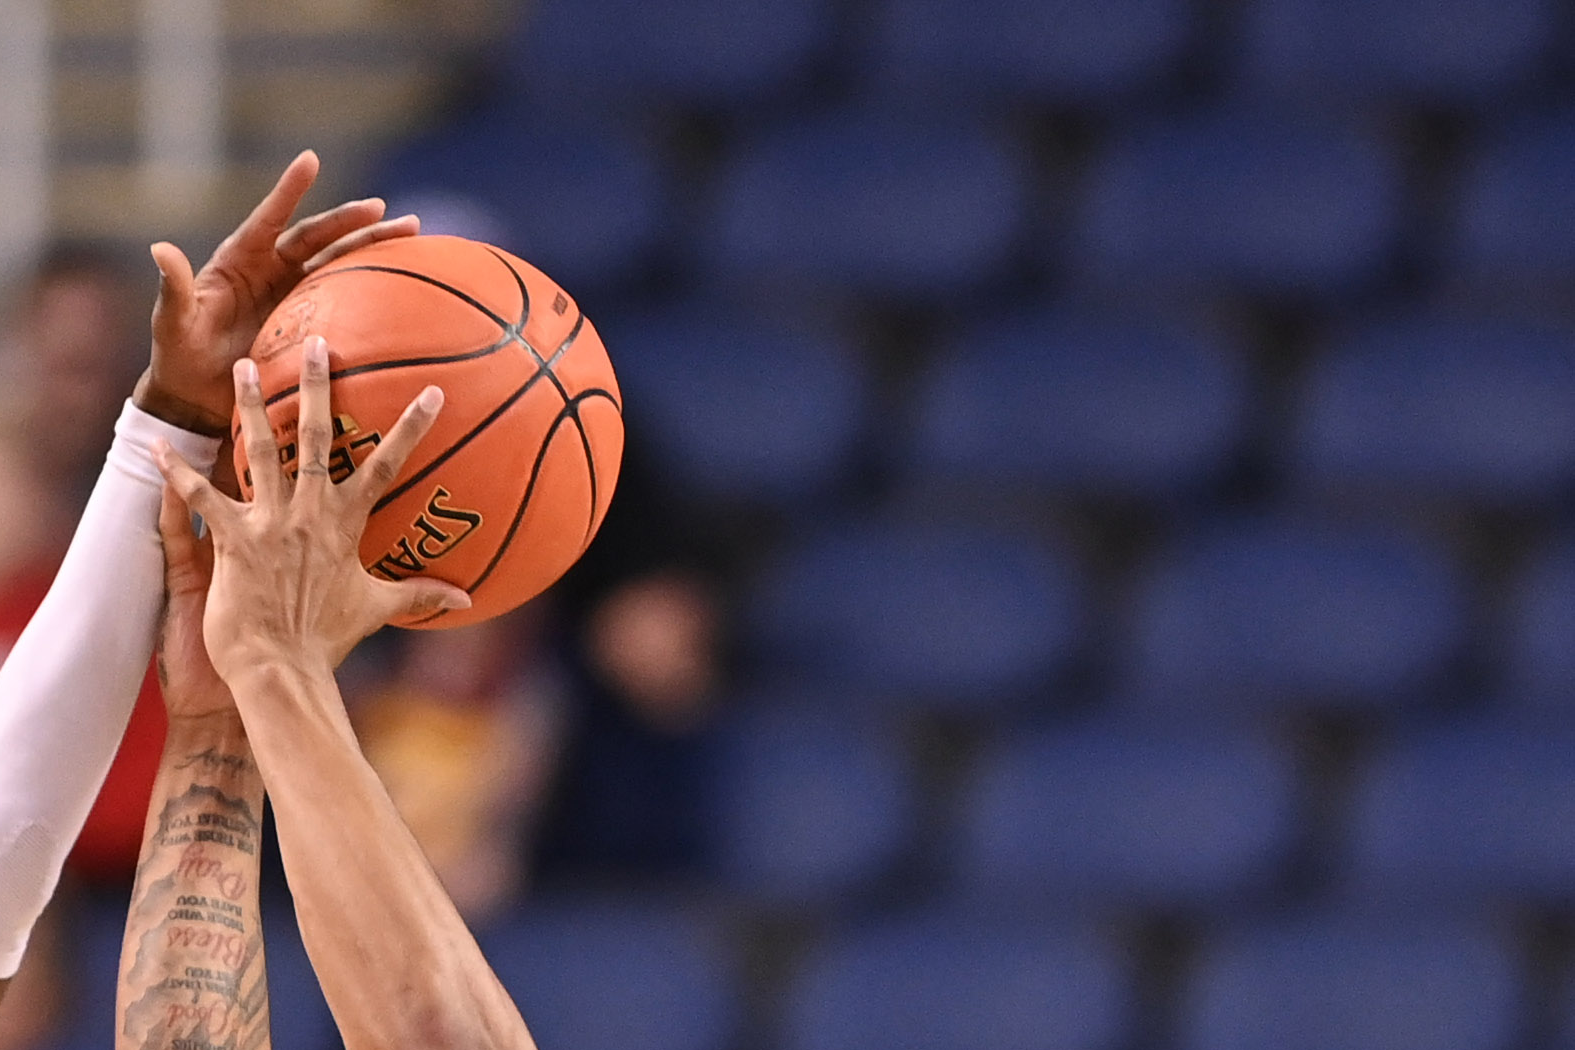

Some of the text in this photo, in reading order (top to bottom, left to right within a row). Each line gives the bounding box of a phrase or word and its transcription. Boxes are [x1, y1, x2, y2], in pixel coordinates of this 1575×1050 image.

[365, 484, 484, 581] SPAL
[168, 908, 204, 921] WHO
[176, 895, 207, 907] YOU
[167, 927, 246, 970] Bless
